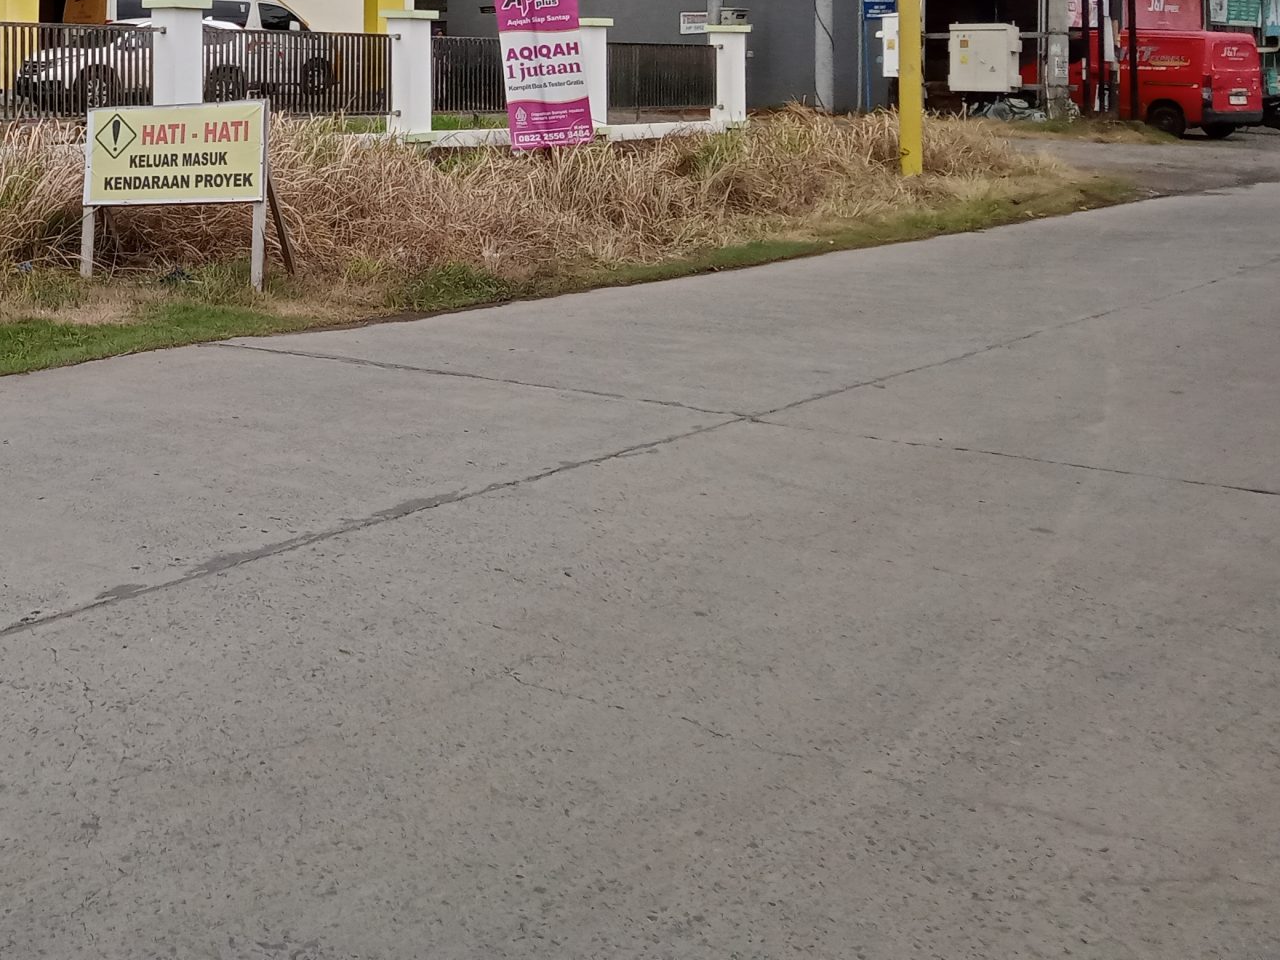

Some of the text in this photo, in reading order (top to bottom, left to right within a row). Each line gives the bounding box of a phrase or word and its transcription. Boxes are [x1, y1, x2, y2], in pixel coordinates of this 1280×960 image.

[507, 17, 530, 26] Aqiqah
[546, 14, 570, 22] Santap
[506, 42, 579, 61] AQIQAH
[507, 61, 582, 82] 1 jutaan
[141, 123, 186, 145] HATI
[204, 120, 249, 143] HATI
[129, 151, 228, 168] KELUAR MASUK
[104, 173, 253, 191] KENDARAAN PROYEK
